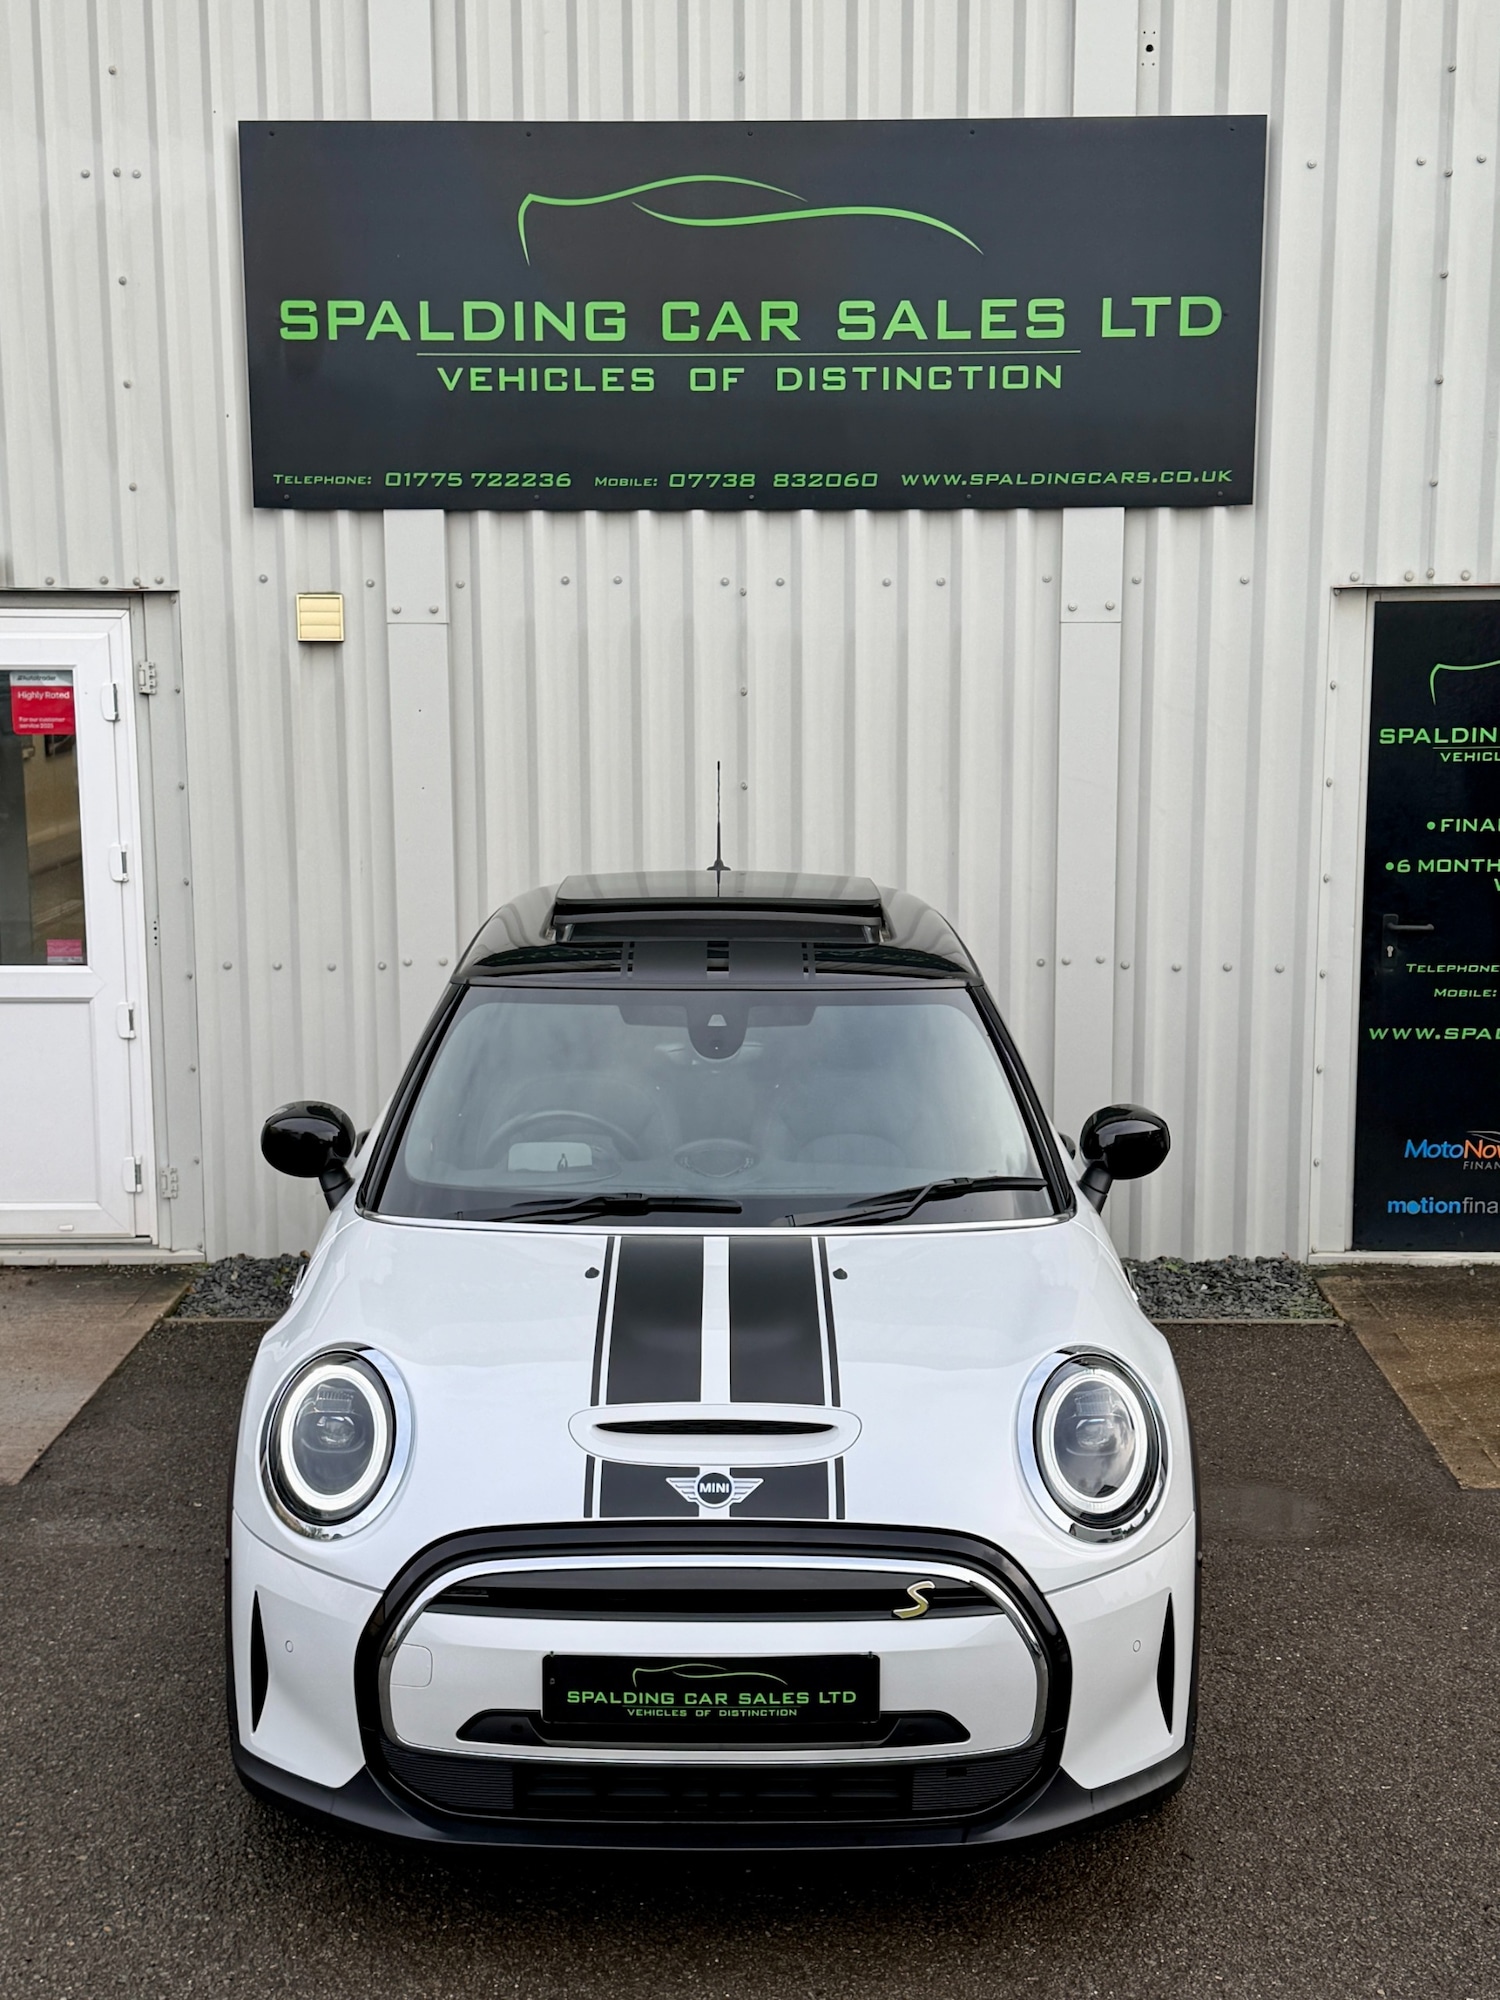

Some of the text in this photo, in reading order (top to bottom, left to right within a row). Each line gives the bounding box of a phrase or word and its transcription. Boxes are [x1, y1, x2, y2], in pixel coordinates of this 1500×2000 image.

[279, 295, 1223, 343] SPALDING CAR SALES LTD
[437, 364, 1063, 393] VEHICLES OF DISTINCTION
[384, 471, 463, 488] 01775
[470, 471, 572, 489] 722236
[668, 472, 757, 489] 07738
[772, 472, 879, 489] 832060
[901, 469, 1233, 487] WWW.SPALDINGCARS.CO.UK
[17, 691, 70, 701] Highly Rated
[1440, 818, 1500, 833] FINA
[699, 1482, 730, 1493] MINI
[566, 1691, 857, 1705] SPALDING CAR SALES LTD
[627, 1708, 797, 1717] VEHICLES OF DISTINCTION
